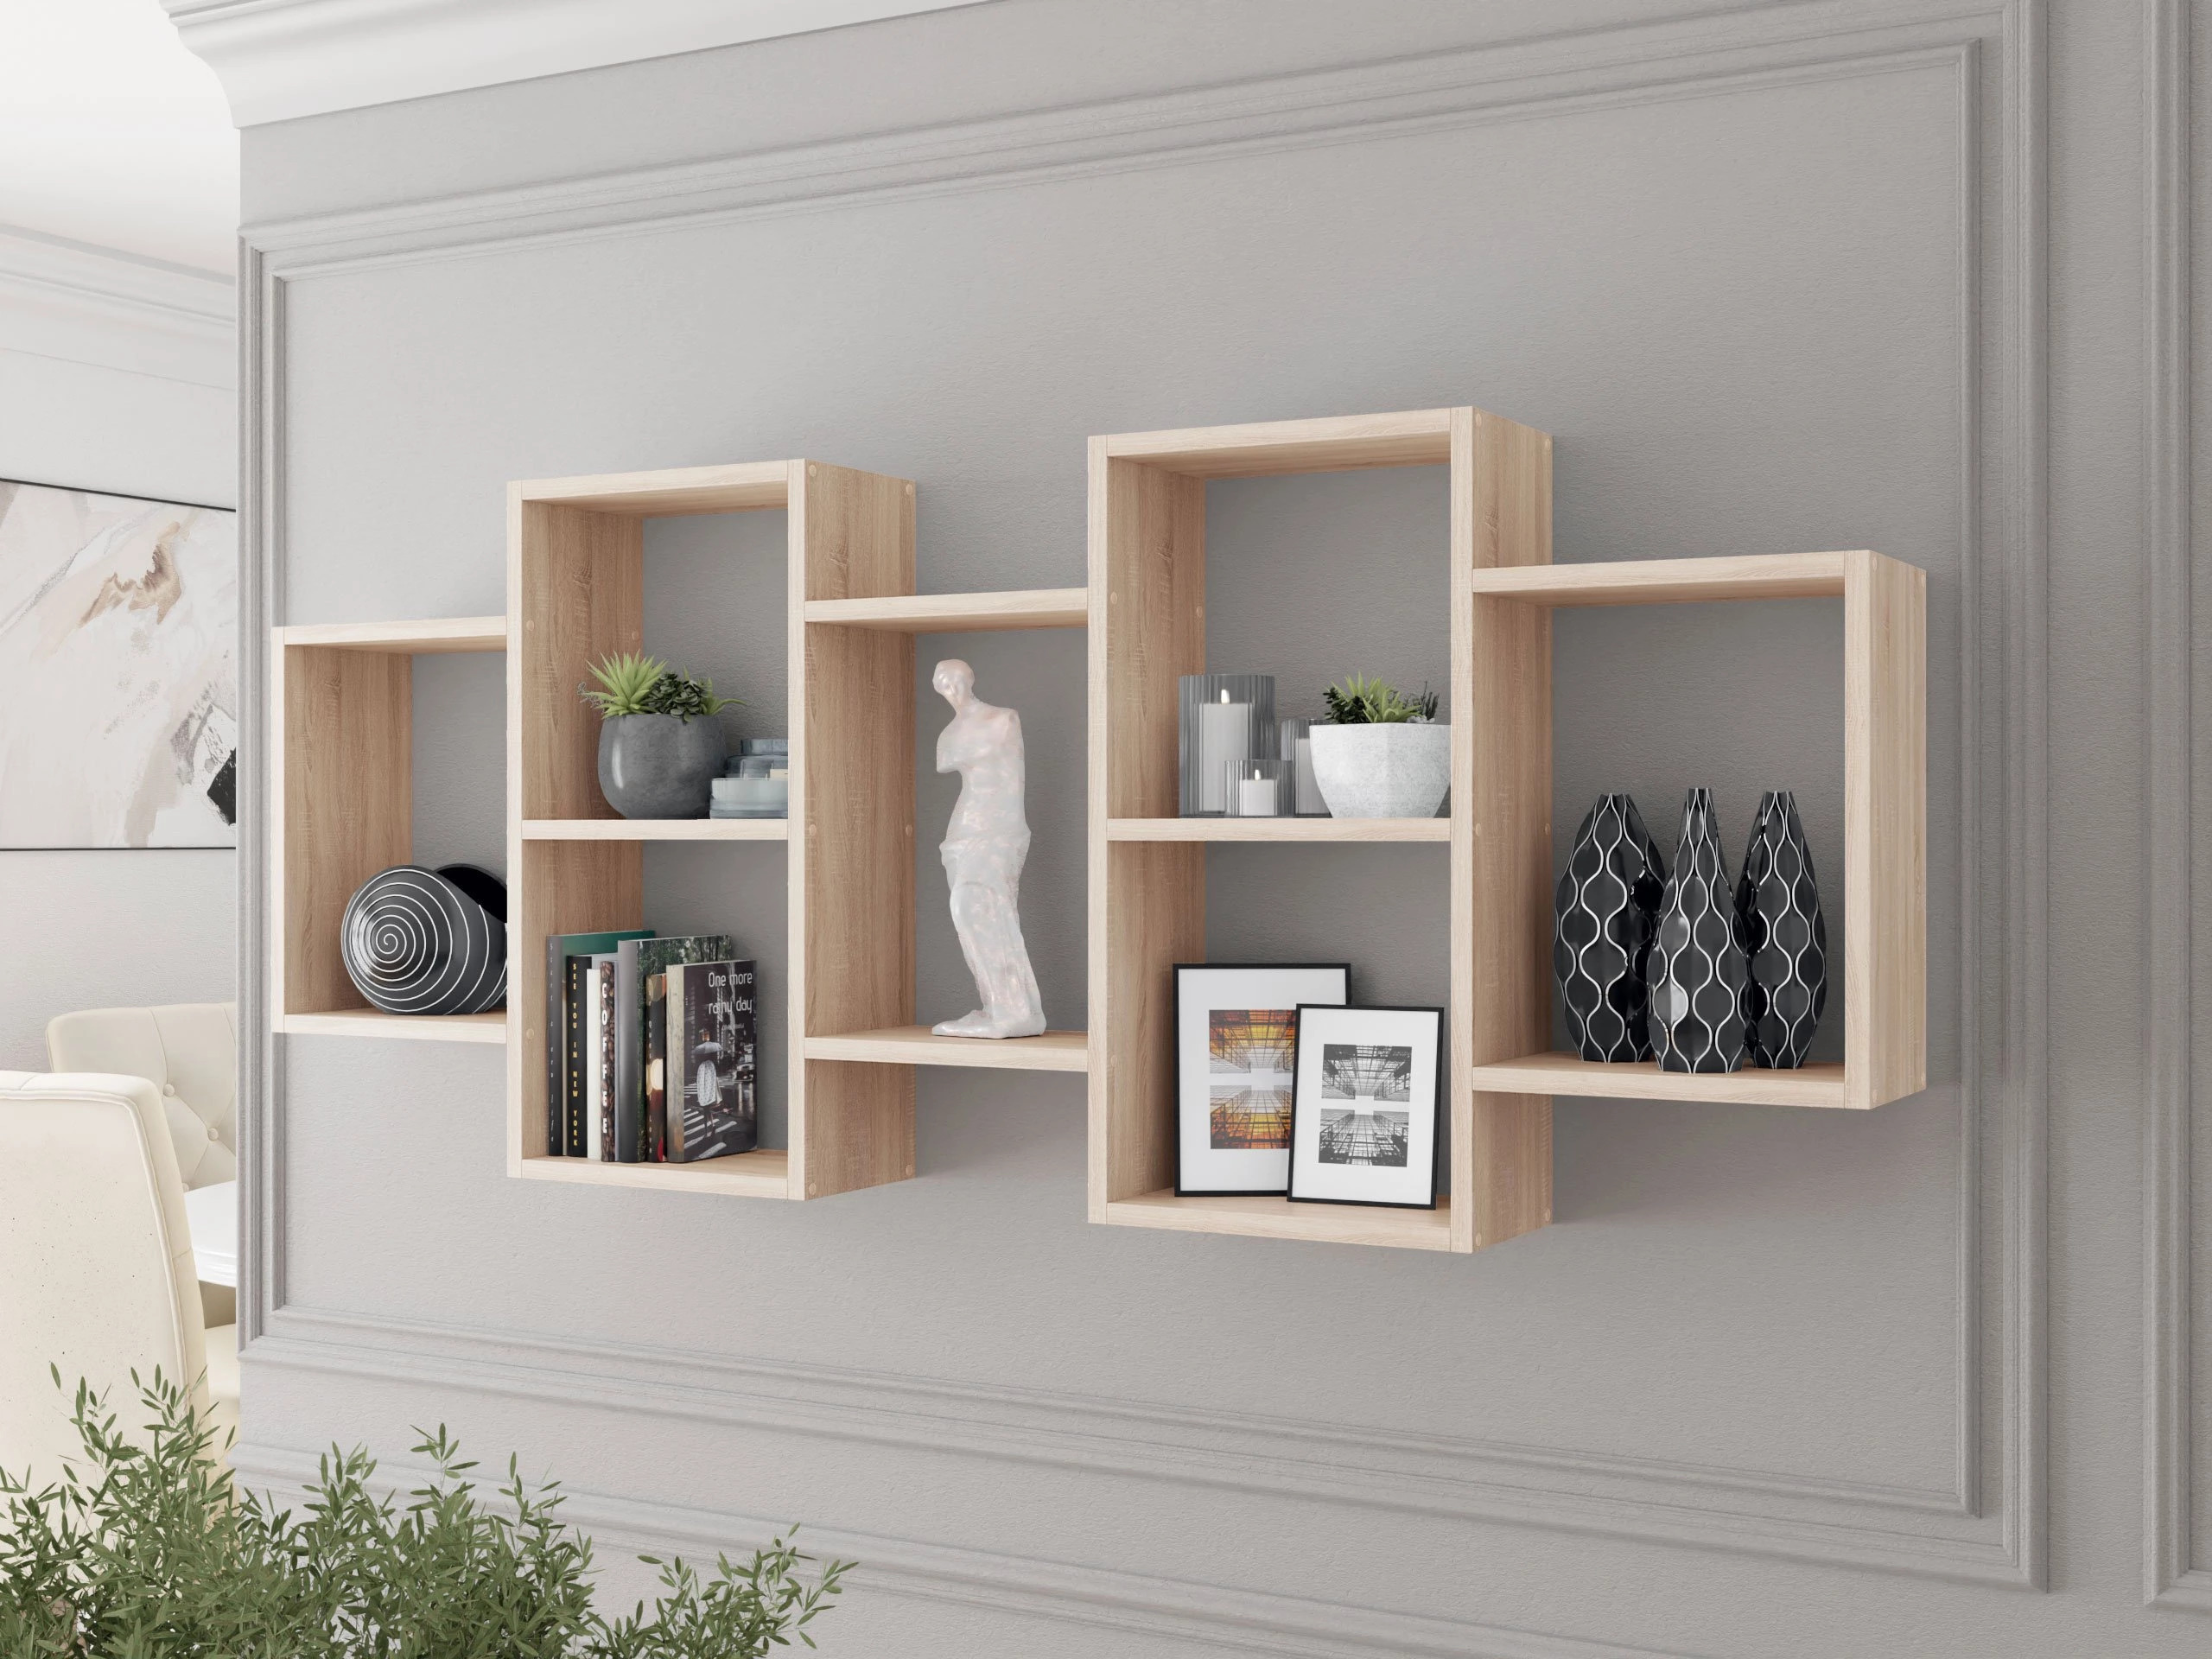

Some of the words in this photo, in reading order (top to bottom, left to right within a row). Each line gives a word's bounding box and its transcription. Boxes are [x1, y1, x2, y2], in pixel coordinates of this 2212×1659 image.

[709, 972, 726, 987] One
[729, 973, 753, 985] more
[709, 1001, 733, 1015] rainy
[736, 996, 753, 1014] day
[573, 1041, 578, 1058] IN
